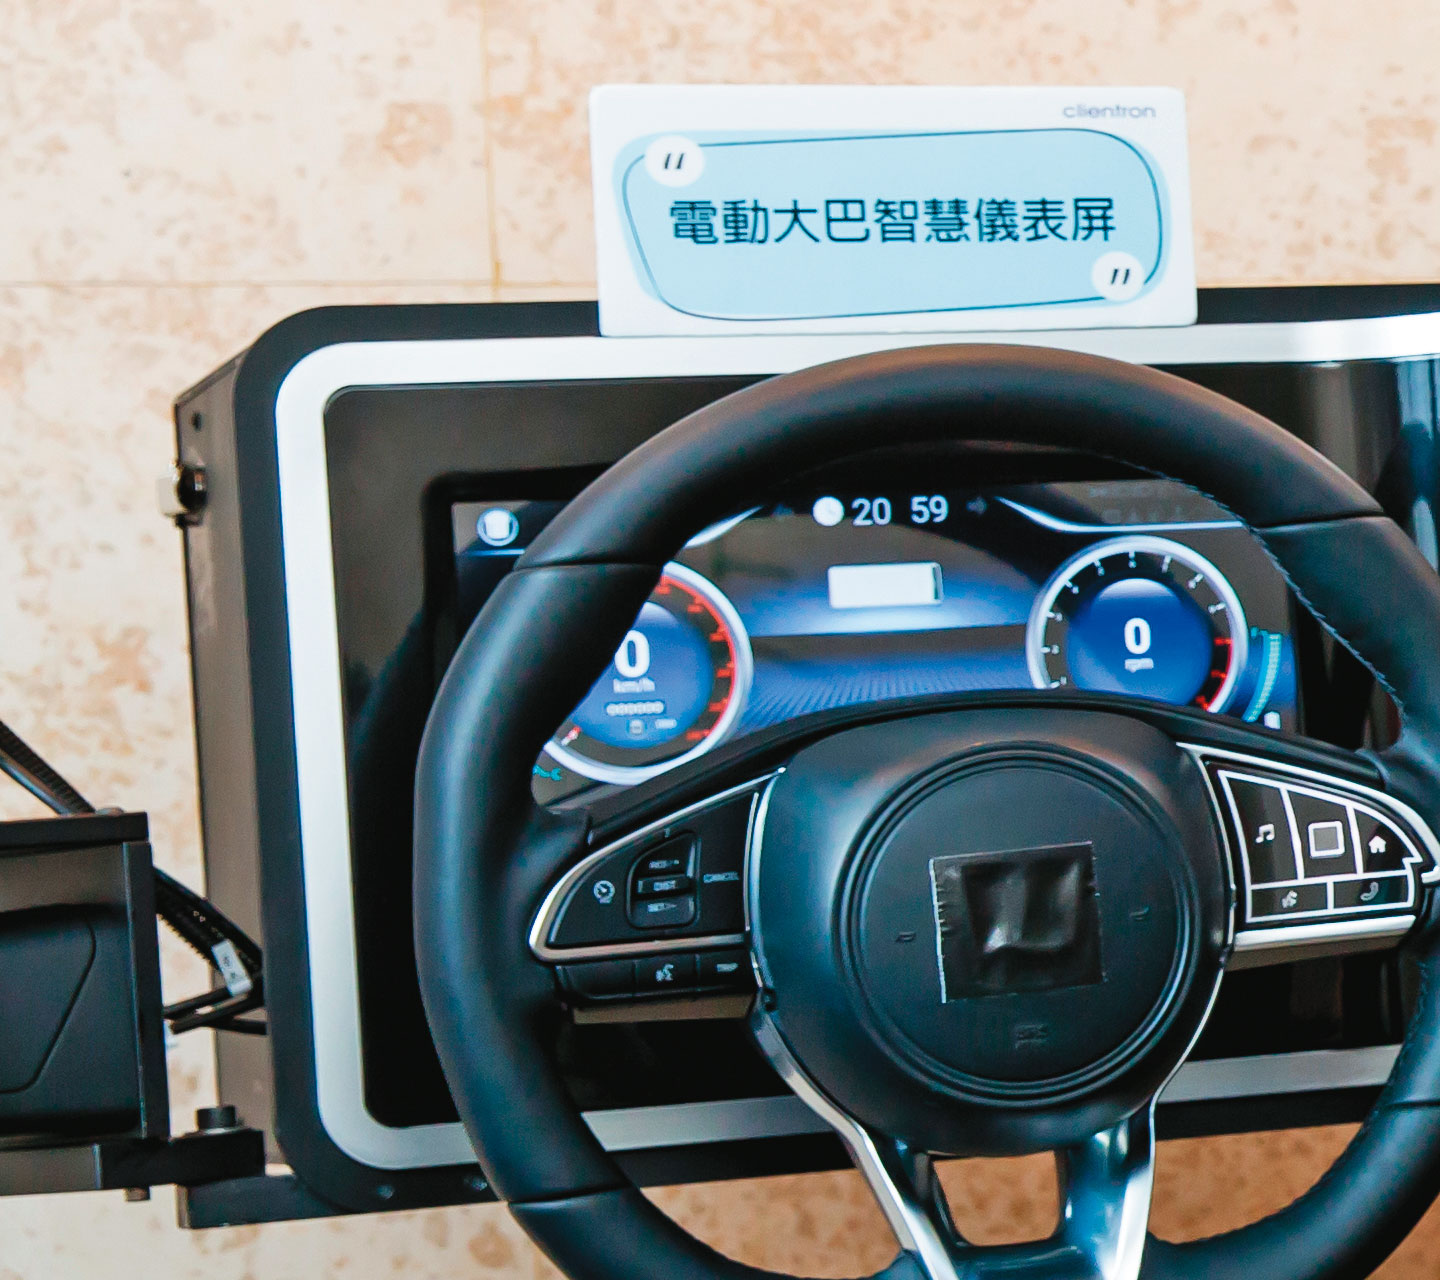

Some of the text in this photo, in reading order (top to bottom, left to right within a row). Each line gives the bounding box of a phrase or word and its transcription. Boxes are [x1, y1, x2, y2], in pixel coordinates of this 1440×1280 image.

[1063, 102, 1156, 120] clientron
[668, 196, 1116, 245] 電動大巴智慧儀表屏
[851, 494, 949, 526] 20 59
[614, 629, 650, 678] 0
[1124, 617, 1151, 655] 0
